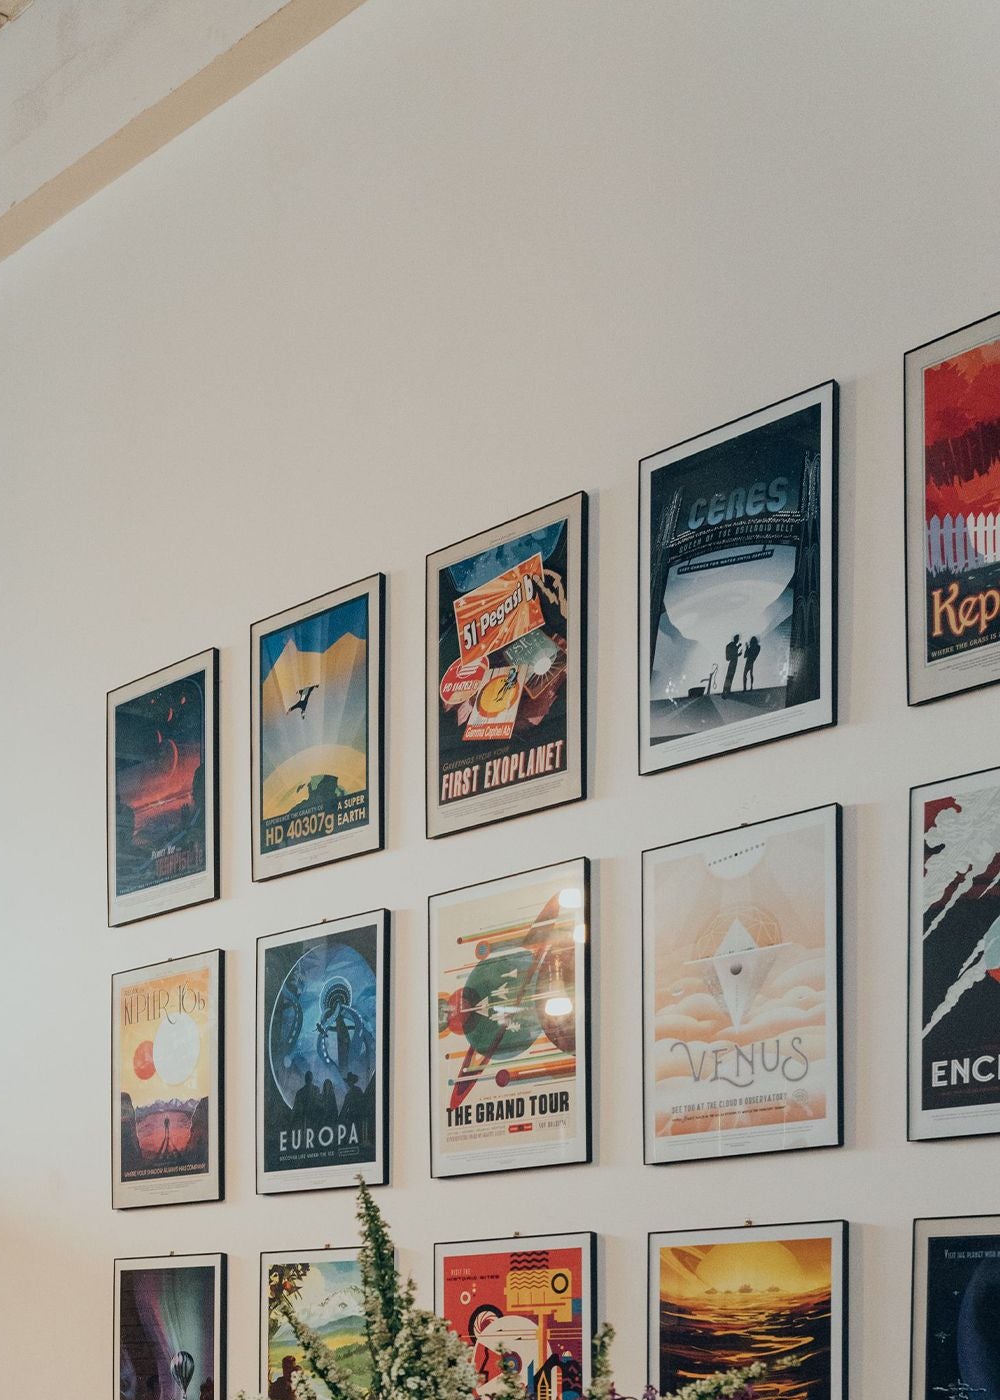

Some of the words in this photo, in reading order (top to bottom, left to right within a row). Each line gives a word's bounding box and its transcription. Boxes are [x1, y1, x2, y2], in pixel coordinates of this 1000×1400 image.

[687, 476, 789, 530] CERES
[463, 620, 478, 650] 51
[480, 581, 523, 637] Pegasi
[523, 574, 534, 602] b
[441, 764, 481, 801] FIRST
[484, 739, 564, 789] EXOPLANET
[337, 801, 343, 811] A
[344, 794, 365, 809] SUPER
[337, 807, 366, 826] EARTH
[265, 825, 284, 847] HD
[286, 811, 335, 839] 40307g
[669, 1036, 809, 1088] VENUS
[931, 1054, 1000, 1088] ENC
[446, 1104, 472, 1127] THE
[476, 1097, 525, 1124] GRAND
[529, 1090, 570, 1117] TOUR
[672, 1105, 683, 1114] SEE
[684, 1104, 695, 1112] YOU
[696, 1102, 705, 1111] AT
[707, 1101, 717, 1110] THE
[718, 1098, 738, 1108] CLOUD
[744, 1092, 788, 1106] OBSERVATORY
[279, 1122, 359, 1152] EUROPA
